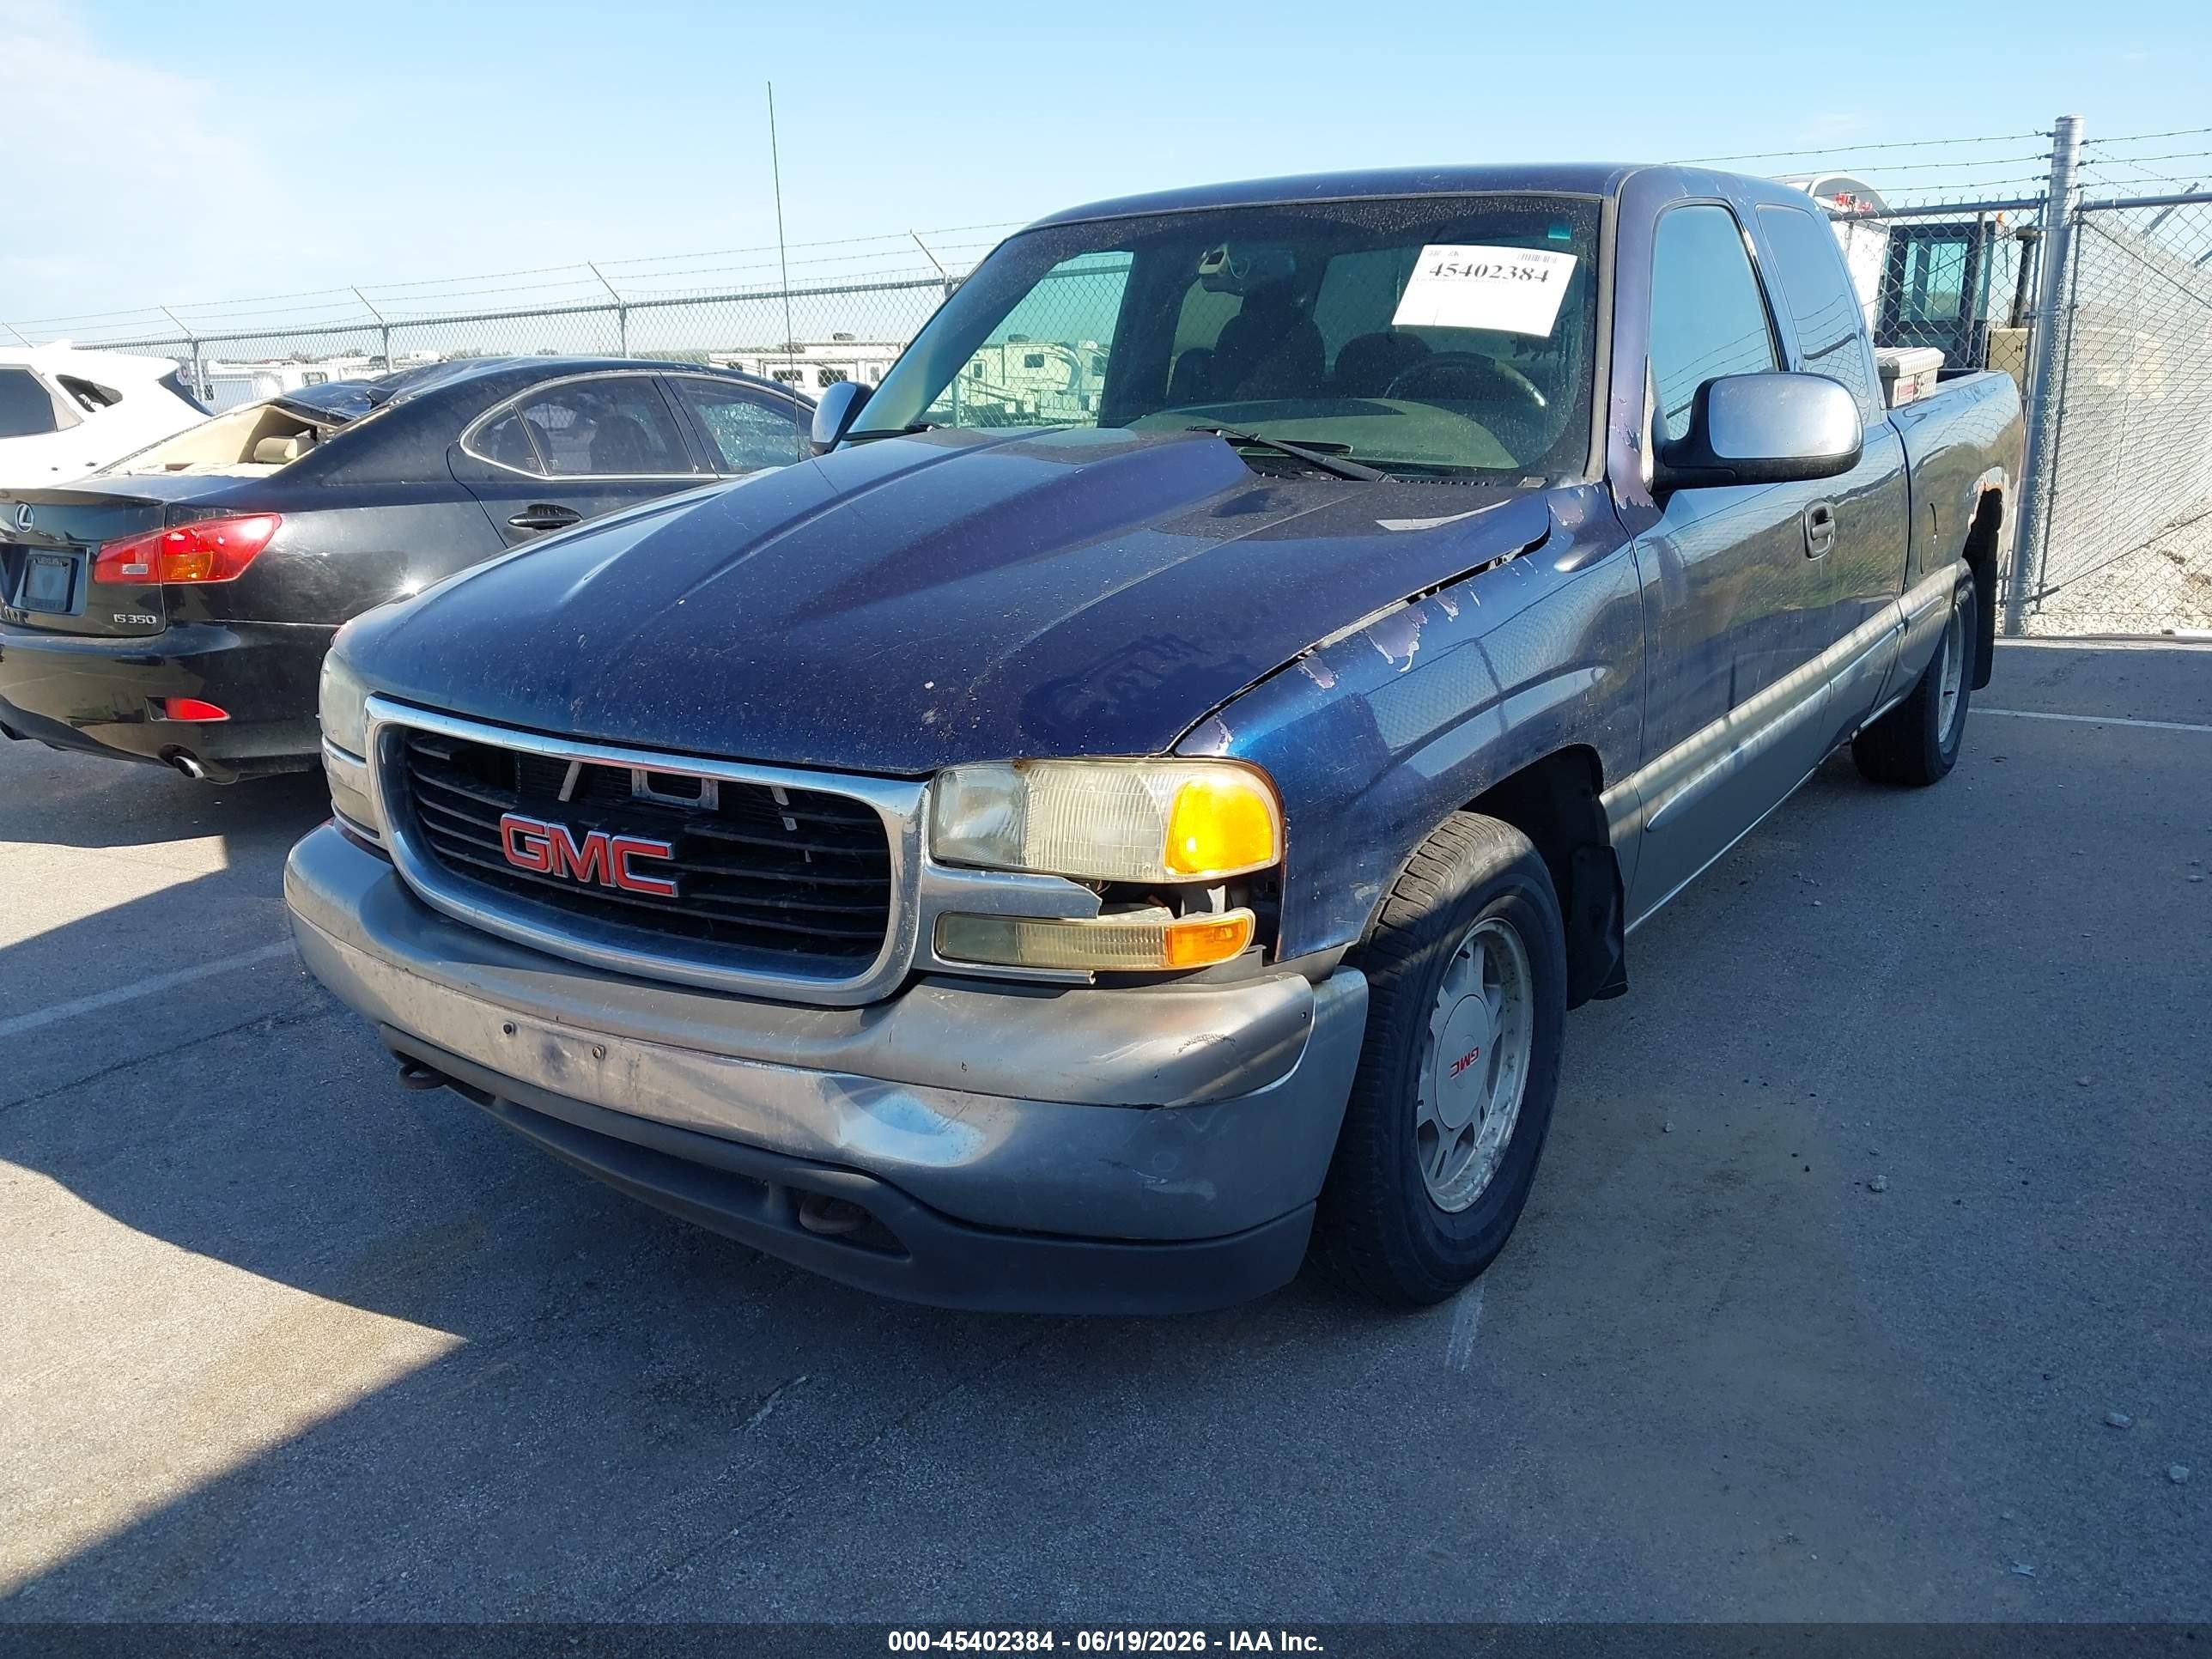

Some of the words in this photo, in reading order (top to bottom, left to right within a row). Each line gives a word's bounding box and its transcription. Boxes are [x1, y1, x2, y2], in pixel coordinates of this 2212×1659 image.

[1428, 262, 1549, 283] 45402384
[501, 812, 678, 898] GMC
[1449, 1046, 1479, 1079] GMC
